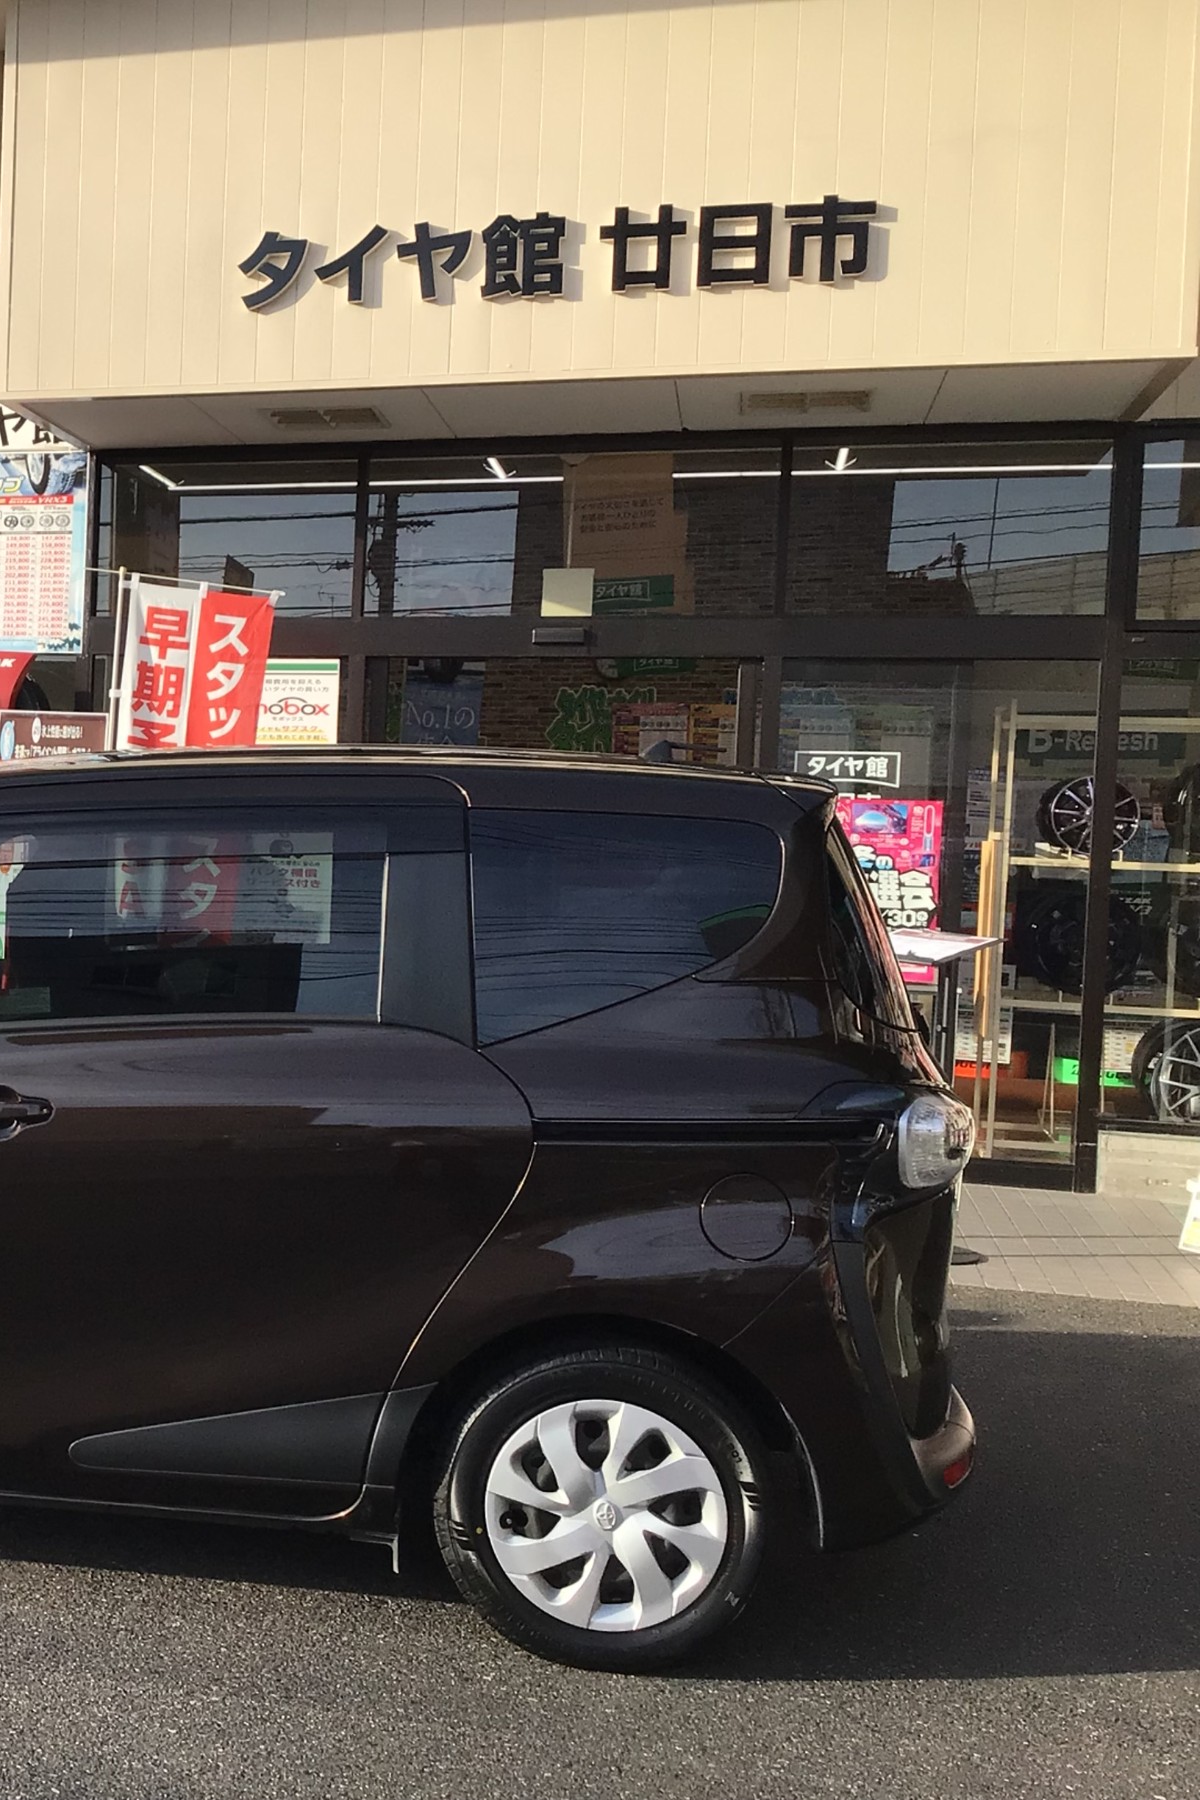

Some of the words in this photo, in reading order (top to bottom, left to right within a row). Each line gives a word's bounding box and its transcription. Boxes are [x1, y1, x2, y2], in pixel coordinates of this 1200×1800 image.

[237, 211, 567, 311] タイヤ館
[599, 194, 877, 293] 廿日市
[595, 583, 644, 599] タイヤ館
[206, 613, 250, 739] スタッ
[405, 700, 475, 731] No.1の
[1026, 729, 1159, 754] B-Reesh
[807, 755, 889, 778] タイヤ館
[864, 869, 937, 912] 選会
